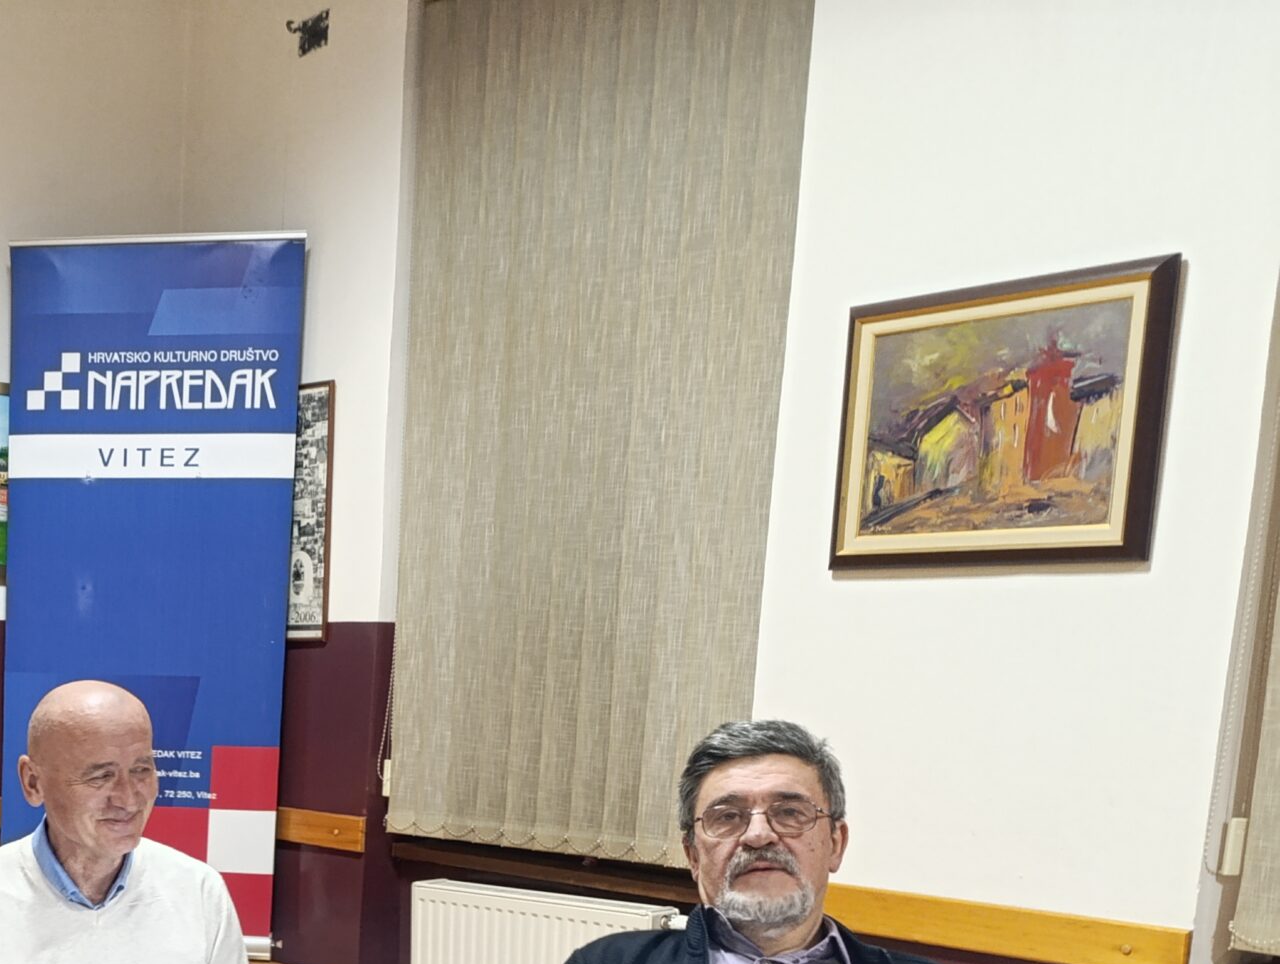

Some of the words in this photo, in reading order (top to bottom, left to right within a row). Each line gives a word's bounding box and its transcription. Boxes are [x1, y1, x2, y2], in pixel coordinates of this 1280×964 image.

[88, 351, 151, 363] HRVATSKO
[154, 350, 217, 363] KULTURNO
[220, 347, 279, 362] DRUŠTVO
[87, 369, 277, 410] NAPREDAK
[98, 448, 200, 469] VITEZ
[152, 750, 175, 759] EDAK
[176, 750, 202, 760] VITEZ
[156, 769, 200, 778] ak-vitez.ba
